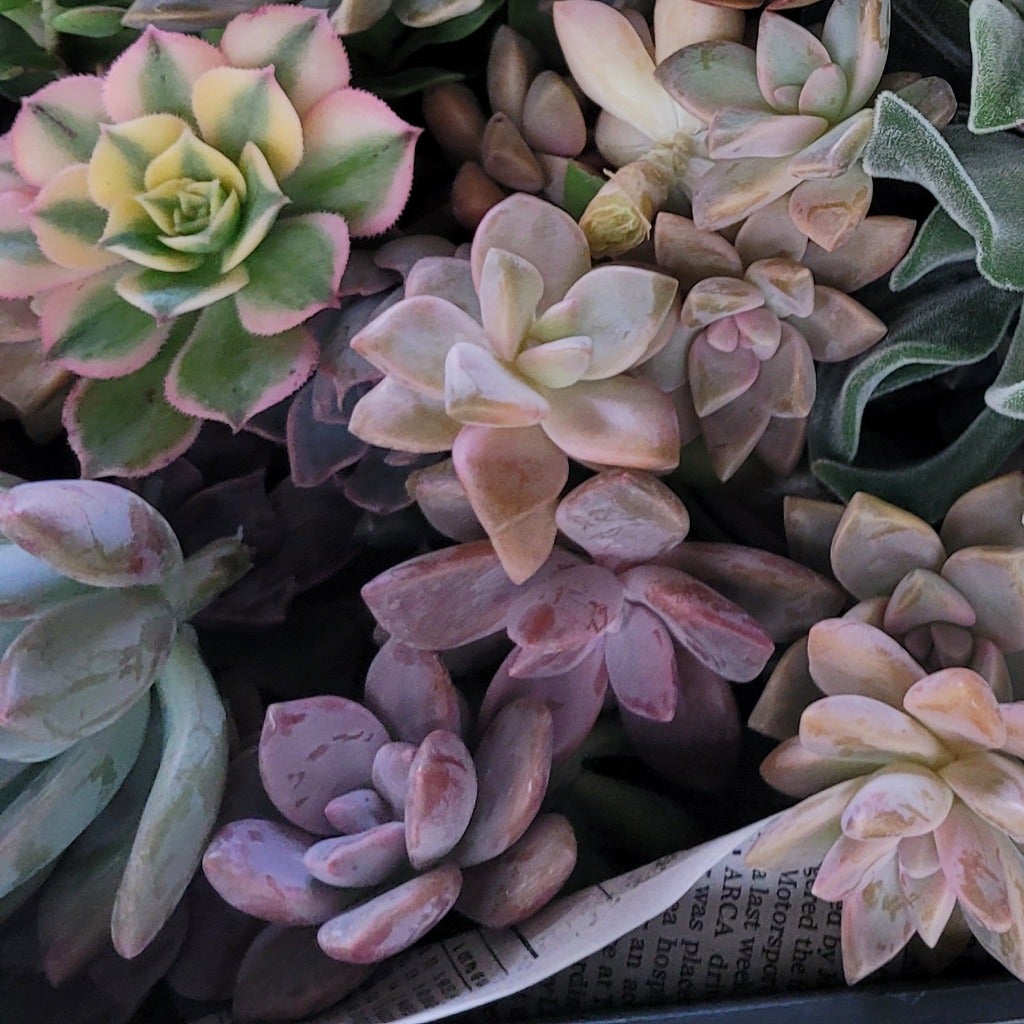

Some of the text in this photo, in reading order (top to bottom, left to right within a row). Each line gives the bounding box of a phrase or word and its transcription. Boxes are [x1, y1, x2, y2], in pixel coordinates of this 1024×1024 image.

[688, 884, 711, 931] was
[714, 865, 743, 939] ARCA
[743, 885, 770, 931] last
[626, 937, 646, 969] an
[791, 937, 814, 974] the
[817, 933, 842, 964] by
